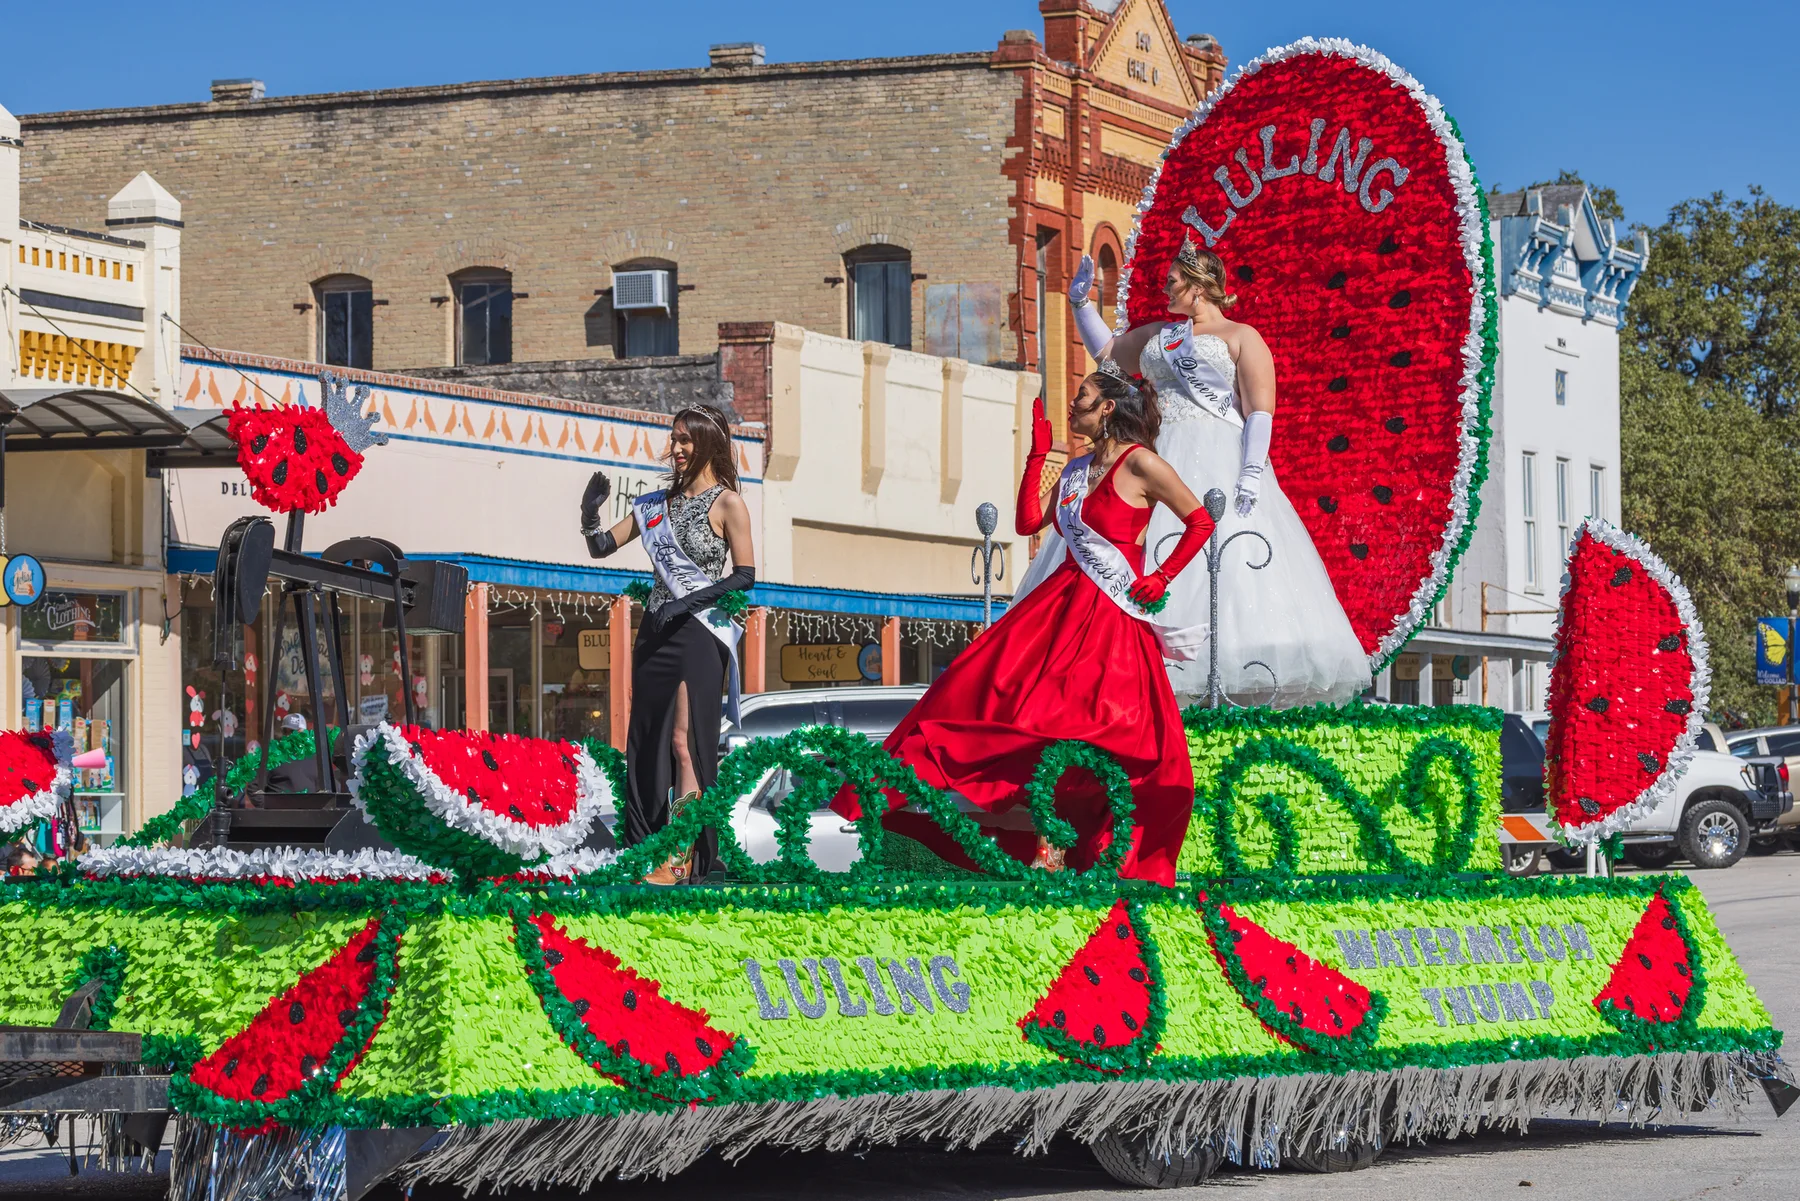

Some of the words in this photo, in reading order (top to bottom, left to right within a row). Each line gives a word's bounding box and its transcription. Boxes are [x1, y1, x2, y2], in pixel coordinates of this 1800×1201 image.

[1181, 118, 1410, 248] LULING
[1172, 356, 1219, 402] Queen
[653, 535, 699, 592] Duches
[1066, 510, 1117, 581] Princess
[1109, 570, 1132, 598] 2021
[799, 646, 833, 661] Heart
[836, 646, 847, 659] &
[808, 664, 838, 679] Soul
[1332, 922, 1595, 969] WATERMELON
[739, 955, 971, 1020] LULING
[1420, 980, 1555, 1027] THUMP
